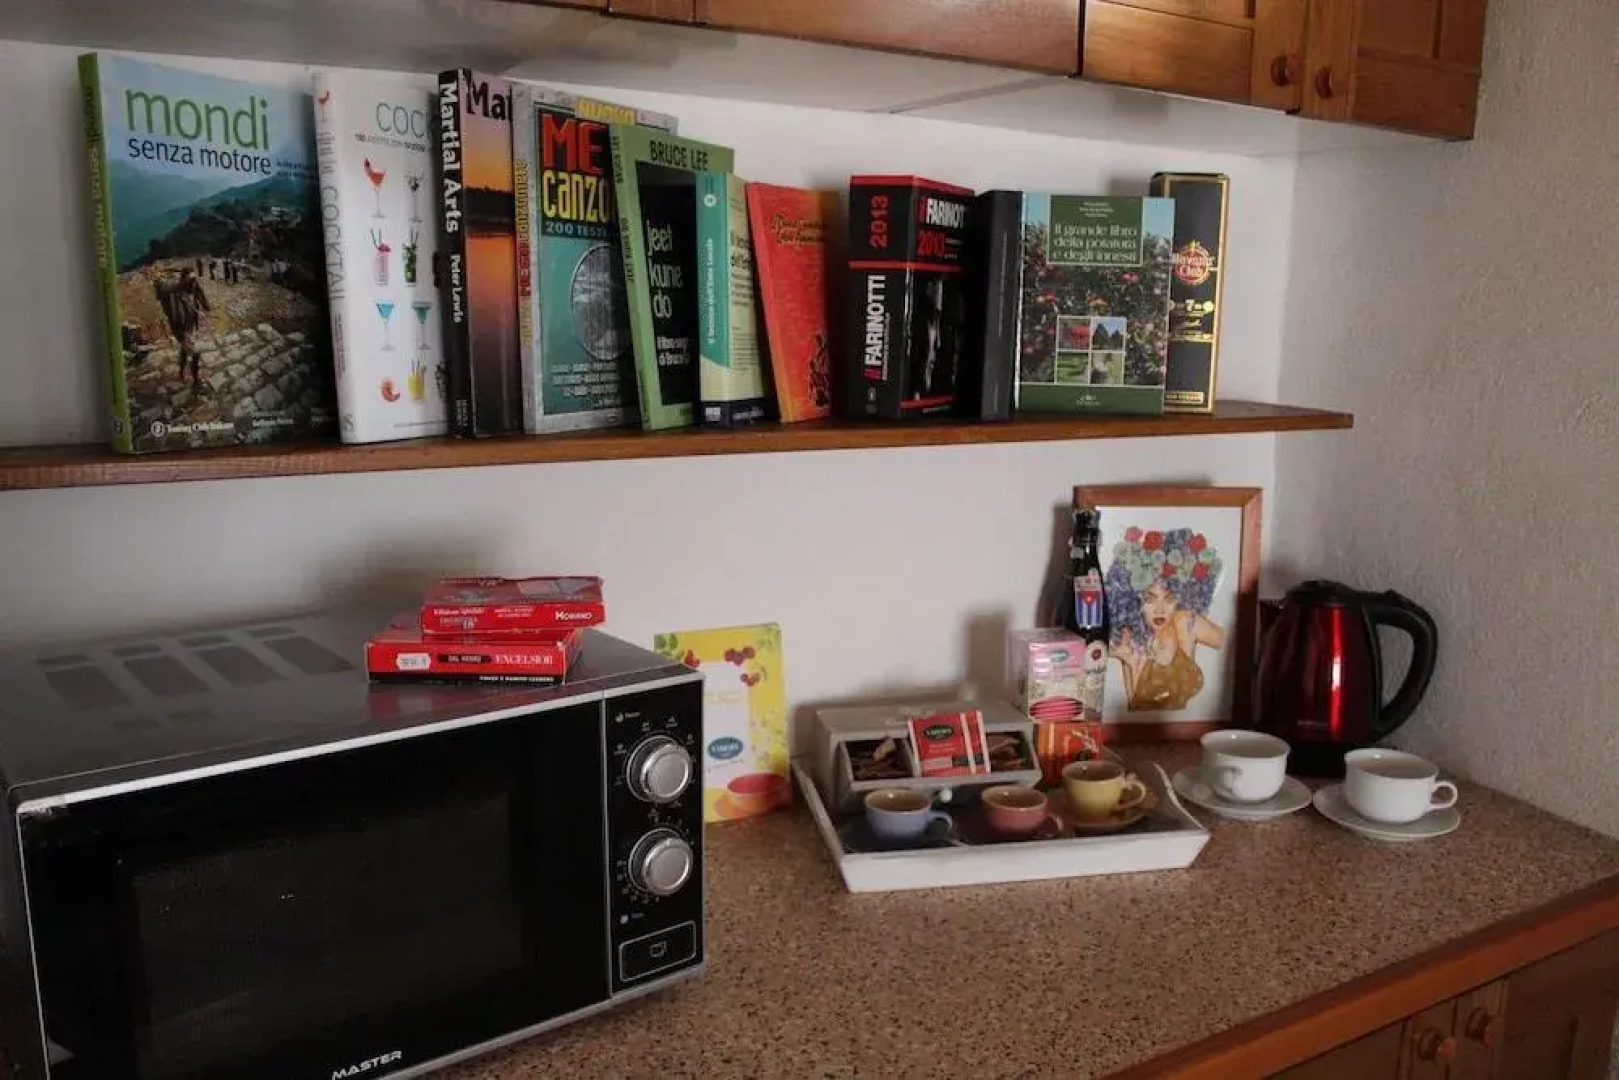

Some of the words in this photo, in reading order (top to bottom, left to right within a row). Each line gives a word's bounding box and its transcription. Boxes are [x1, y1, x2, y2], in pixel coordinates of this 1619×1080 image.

[125, 89, 269, 150] mondi
[440, 82, 461, 172] Martial
[128, 137, 194, 165] senza
[199, 148, 272, 175] motore
[649, 140, 688, 168] BRUCE
[690, 149, 709, 171] LEE
[443, 177, 463, 234] Arts
[870, 194, 889, 250] 2013
[322, 185, 346, 301] COCKTAIL
[545, 221, 574, 234] 200
[645, 219, 673, 255] jeet
[1054, 236, 1084, 249] della
[1085, 237, 1137, 251] potatura
[1062, 224, 1107, 238] grande
[1110, 224, 1138, 237] libro
[450, 253, 461, 285] Peter
[1063, 249, 1093, 263] degli
[649, 261, 683, 288] kune
[452, 285, 463, 323] Lewis
[653, 291, 672, 319] do
[864, 274, 887, 367] FARINOTTI
[332, 1050, 403, 1080] MASTER
